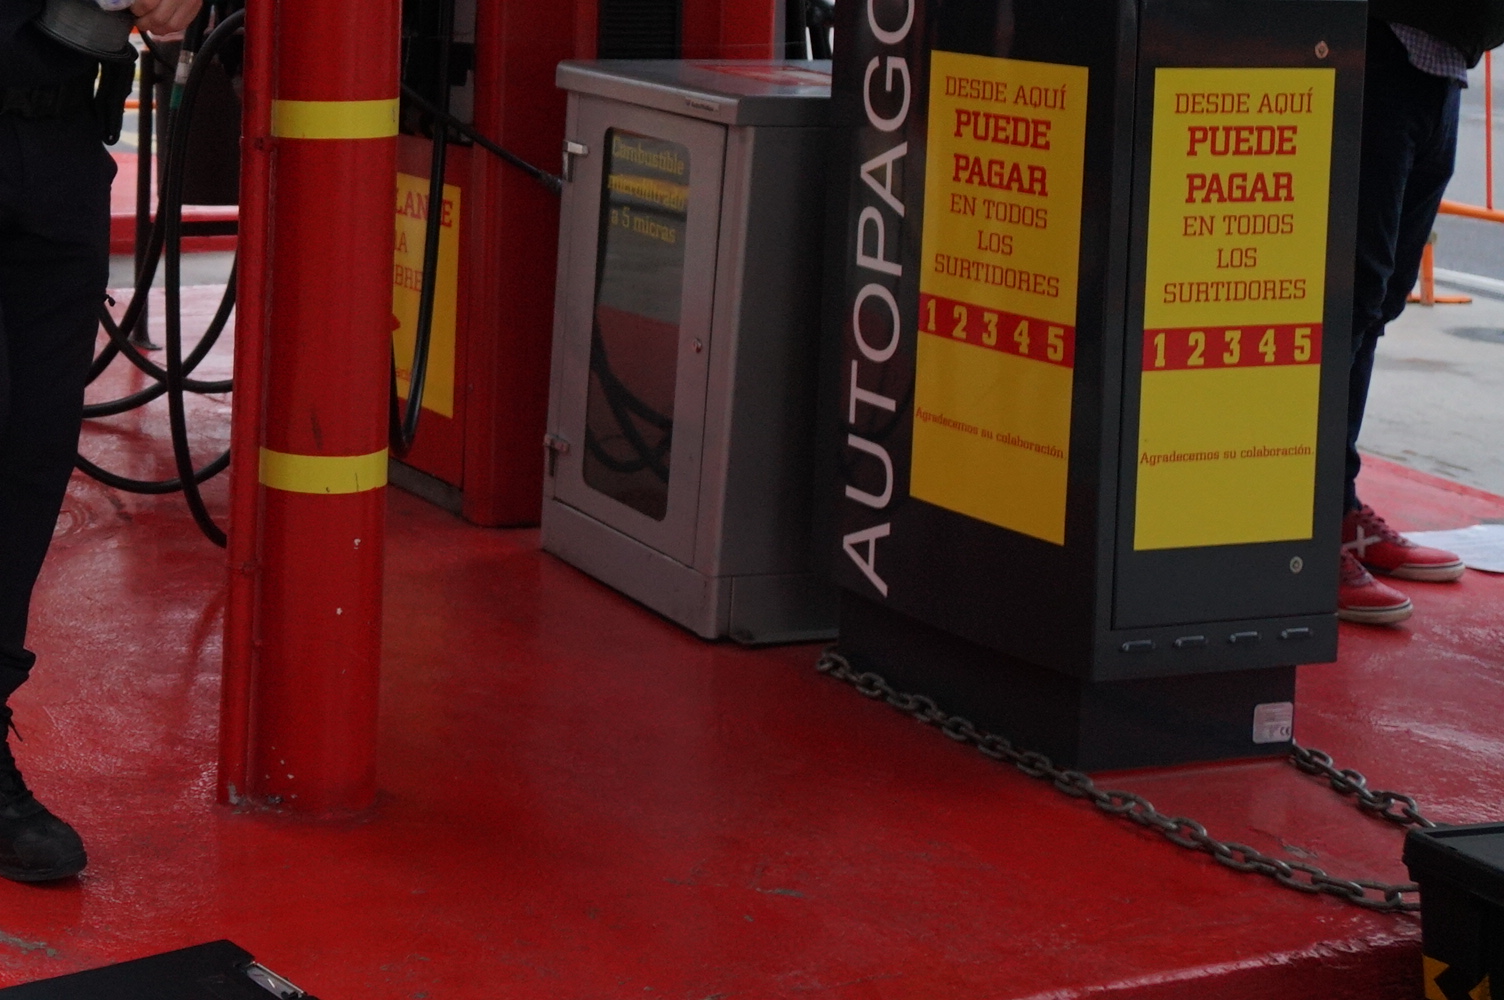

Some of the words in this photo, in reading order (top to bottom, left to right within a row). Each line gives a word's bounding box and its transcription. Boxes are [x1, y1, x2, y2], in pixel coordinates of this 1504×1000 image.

[945, 76, 1007, 103] DESDE
[1014, 83, 1067, 110] AQUÍ
[1175, 92, 1251, 114] DESDE
[1257, 88, 1313, 116] AQUÍ
[953, 109, 1051, 150] PUEDE
[1186, 125, 1297, 156] PUEDE
[613, 135, 685, 175] Combustible
[952, 153, 1048, 197] PAGAR
[1185, 171, 1295, 203] PAGAR
[610, 210, 618, 226] a
[622, 207, 630, 228] 5
[633, 216, 677, 244] micras
[950, 193, 979, 215] EN
[983, 200, 1048, 229] TODOS
[1183, 215, 1215, 236] EN
[1222, 214, 1294, 235] TODOS
[977, 230, 1013, 256] LOS
[1216, 248, 1257, 268] LOS
[934, 253, 1060, 297] SURTIDORES
[1163, 279, 1307, 304] SURTIDORES
[926, 299, 938, 331] 1
[952, 305, 968, 340] 2
[981, 312, 998, 347] 3
[1013, 320, 1031, 354] 4
[1046, 328, 1065, 363] 5
[1152, 332, 1167, 367] 1
[1187, 331, 1206, 366] 2
[1222, 329, 1242, 364] 3
[1257, 328, 1277, 361] 4
[1292, 326, 1312, 360] 5
[915, 406, 979, 437] Agradecemos
[981, 427, 993, 440] su
[1139, 450, 1219, 466] Agradecemos
[1222, 448, 1237, 460] su
